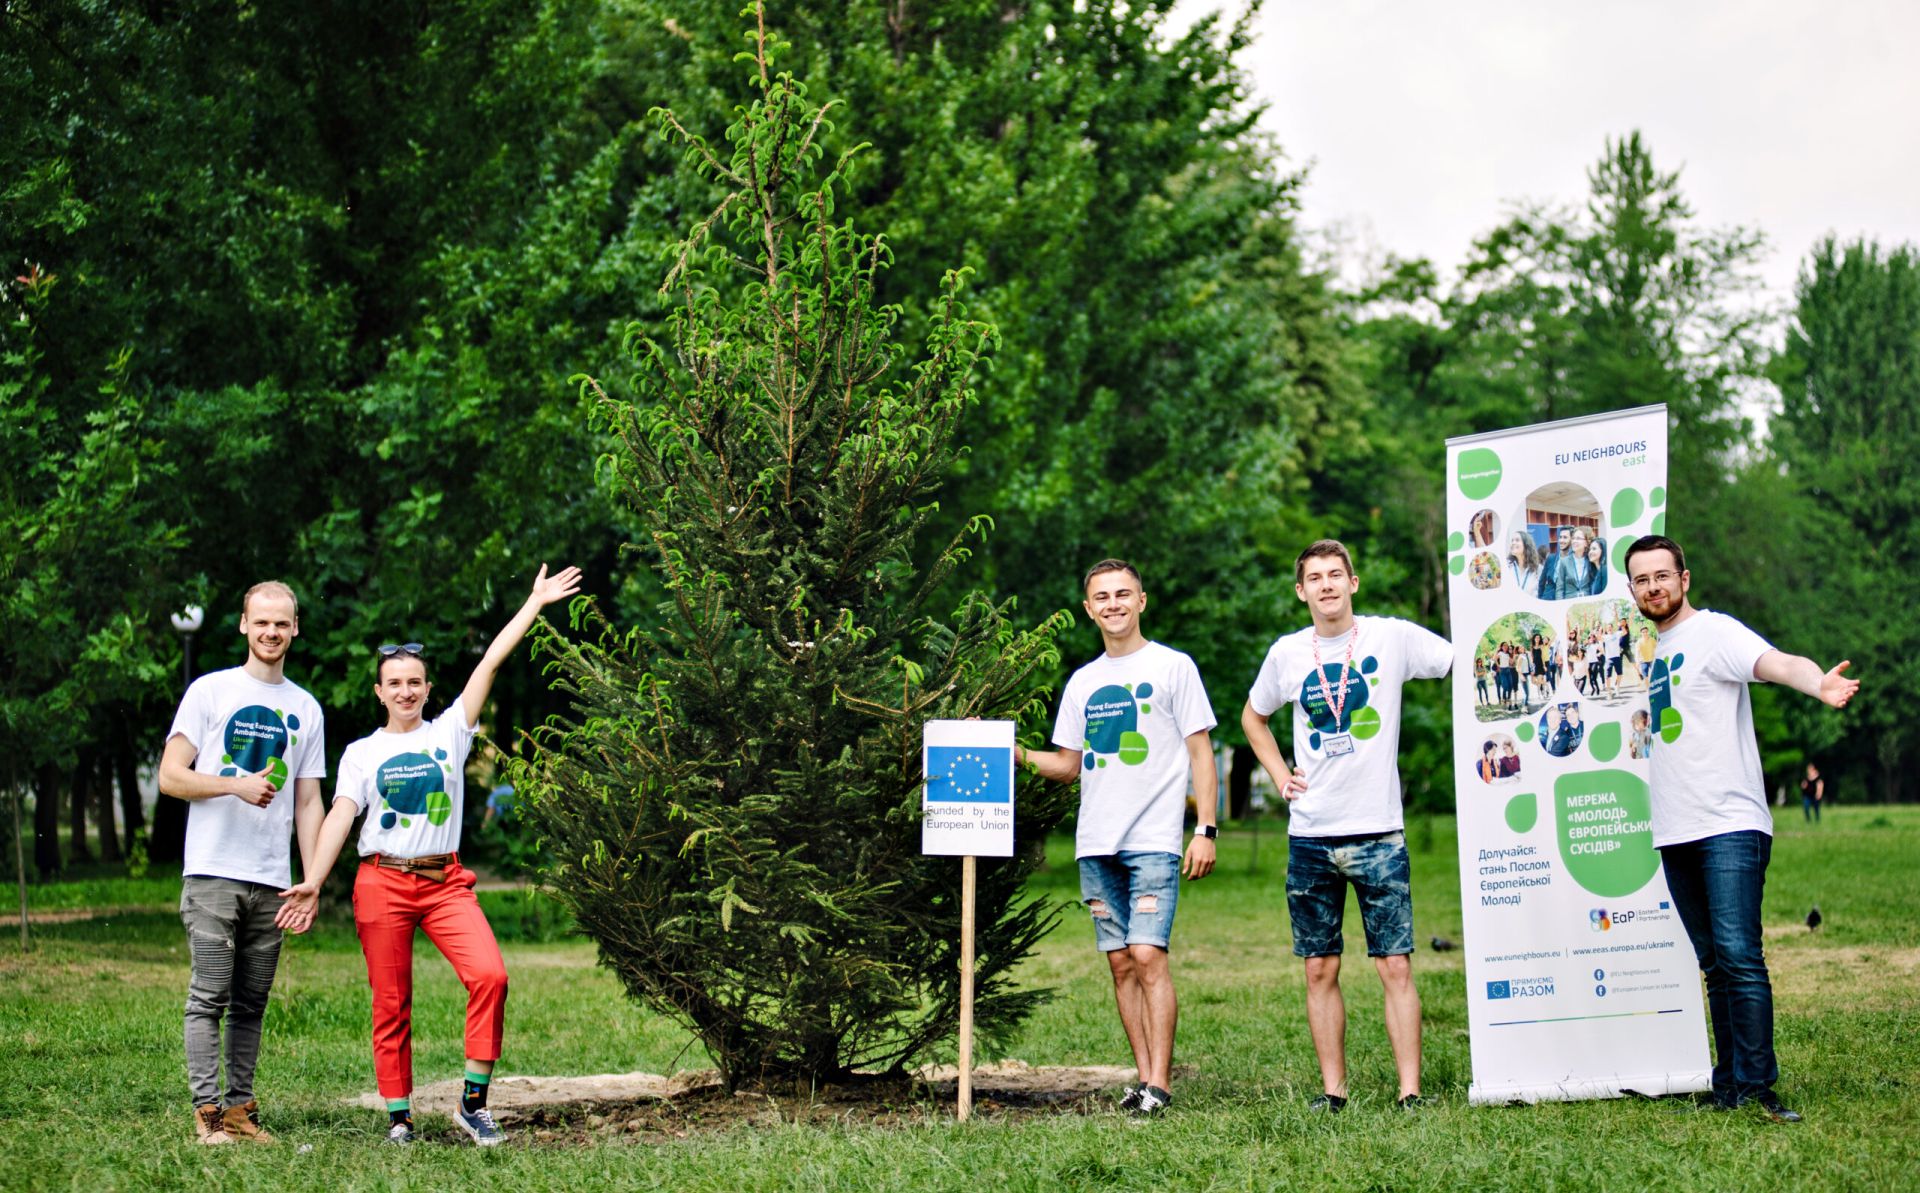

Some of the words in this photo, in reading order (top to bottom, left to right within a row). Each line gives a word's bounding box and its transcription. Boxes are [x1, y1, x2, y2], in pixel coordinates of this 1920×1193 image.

[1555, 453, 1569, 465] EU
[1573, 440, 1647, 462] NEIGHBOURS
[1622, 454, 1646, 467] east
[1104, 701, 1131, 709] European
[1087, 709, 1124, 719] Ambassadors
[234, 720, 254, 730] Young
[255, 722, 284, 733] European
[382, 766, 403, 774] Young
[404, 763, 435, 772] European
[384, 770, 428, 780] Ambassadors
[1566, 792, 1617, 808] МЕРЕЖА
[926, 805, 964, 817] Funded
[973, 807, 985, 818] by
[994, 807, 1010, 817] the
[1567, 807, 1628, 823] «МОЛОДЬ
[926, 819, 974, 831] European
[980, 820, 1010, 831] Union
[1568, 819, 1653, 839] ЄВРОПЕЙСЬКИ
[1478, 845, 1537, 862] Долучайся:
[1479, 865, 1507, 876] стань
[1509, 860, 1551, 873] Послом
[1480, 873, 1551, 892] Європейської
[1481, 892, 1521, 907] Молоді
[1612, 910, 1635, 924] EaP
[1484, 951, 1561, 963] www.euneighbours.eu
[1572, 940, 1675, 956] www.eeas.europa.eu/ukraine
[1511, 984, 1555, 998] РАЗОМ
